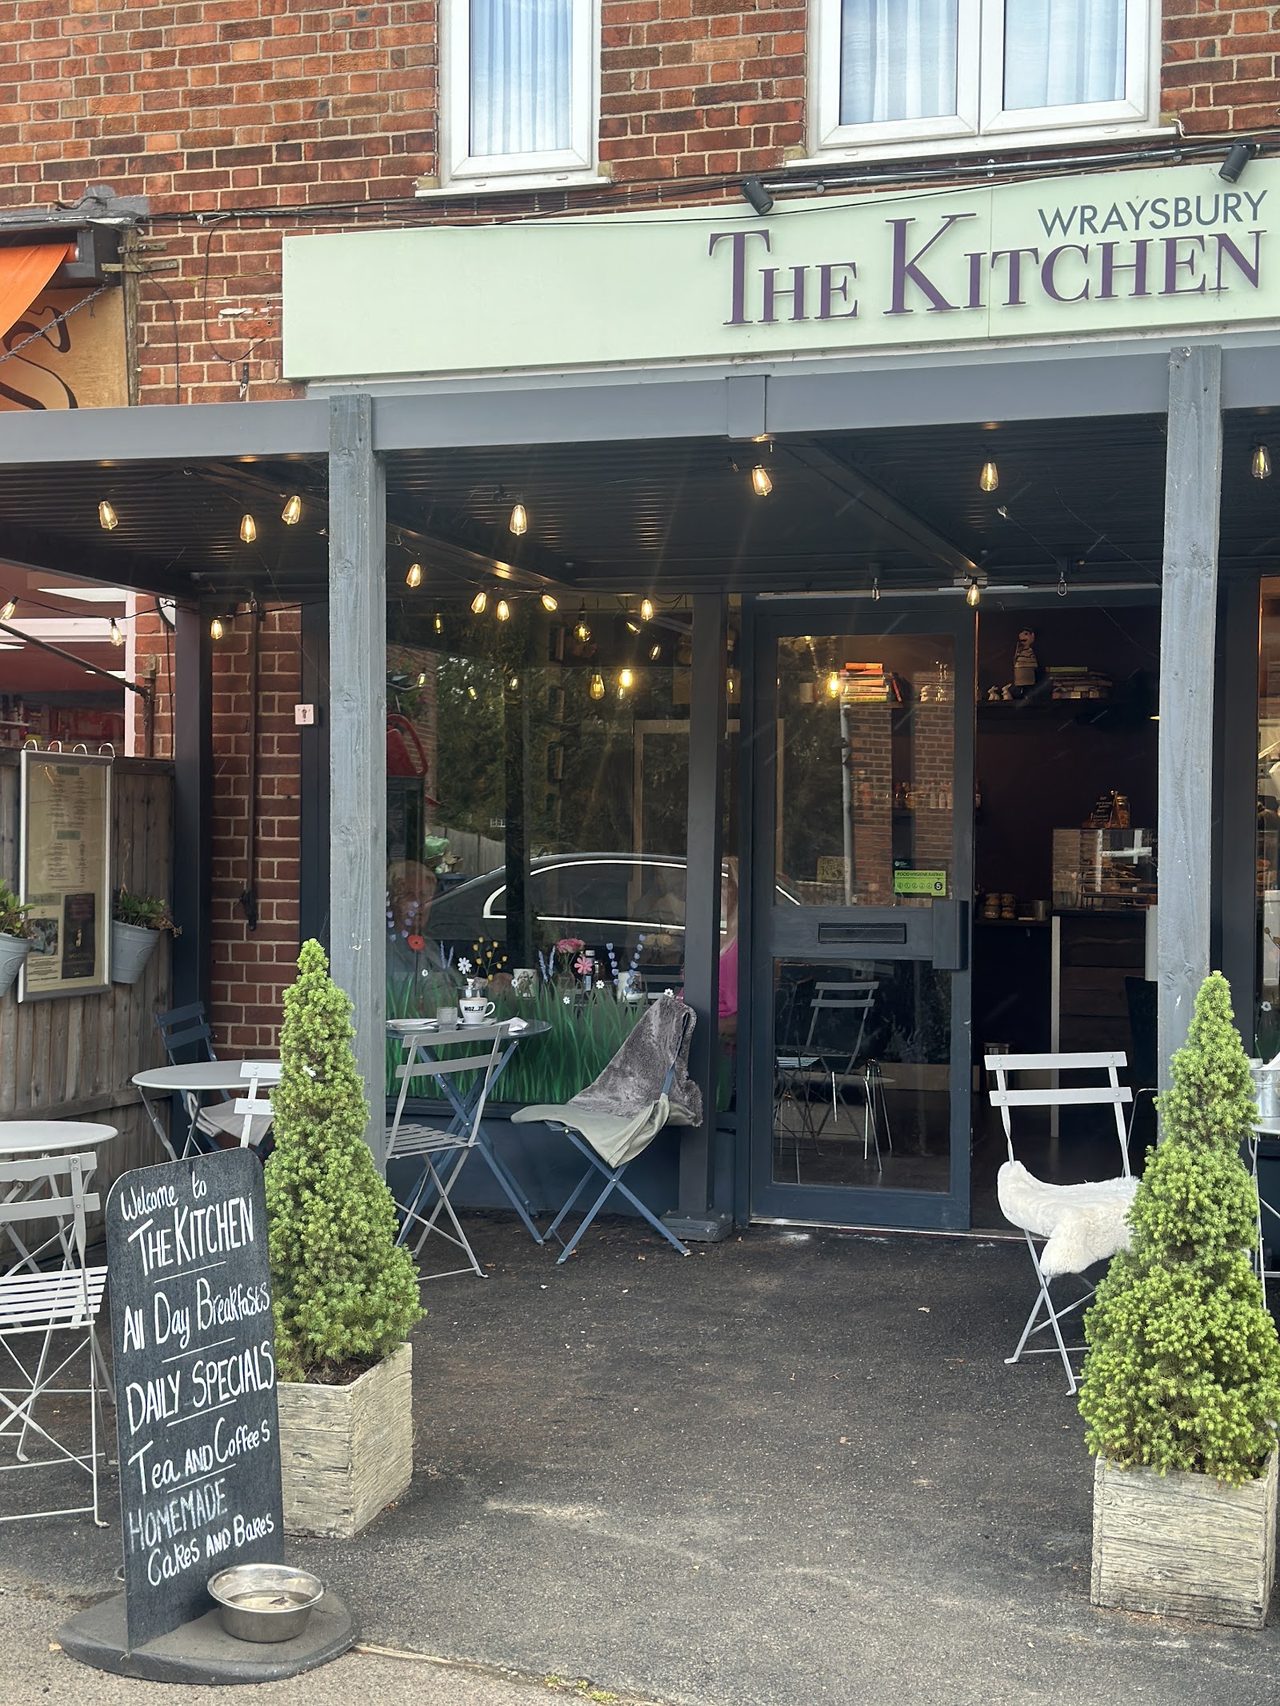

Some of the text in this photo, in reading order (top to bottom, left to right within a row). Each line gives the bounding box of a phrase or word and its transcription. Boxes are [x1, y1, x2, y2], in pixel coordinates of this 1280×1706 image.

[1037, 190, 1269, 238] WRAYSBURY
[708, 212, 1268, 325] THE KITCHEN
[120, 1171, 207, 1221] Welcome to
[127, 1193, 254, 1276] THE KITCHEN
[123, 1277, 270, 1353] All Day Breakfasts
[126, 1340, 274, 1435] DAILY SPECIALS
[127, 1417, 270, 1495] Tea AND Coffees
[128, 1478, 228, 1554] HOMEMADE
[206, 1528, 231, 1558] AND
